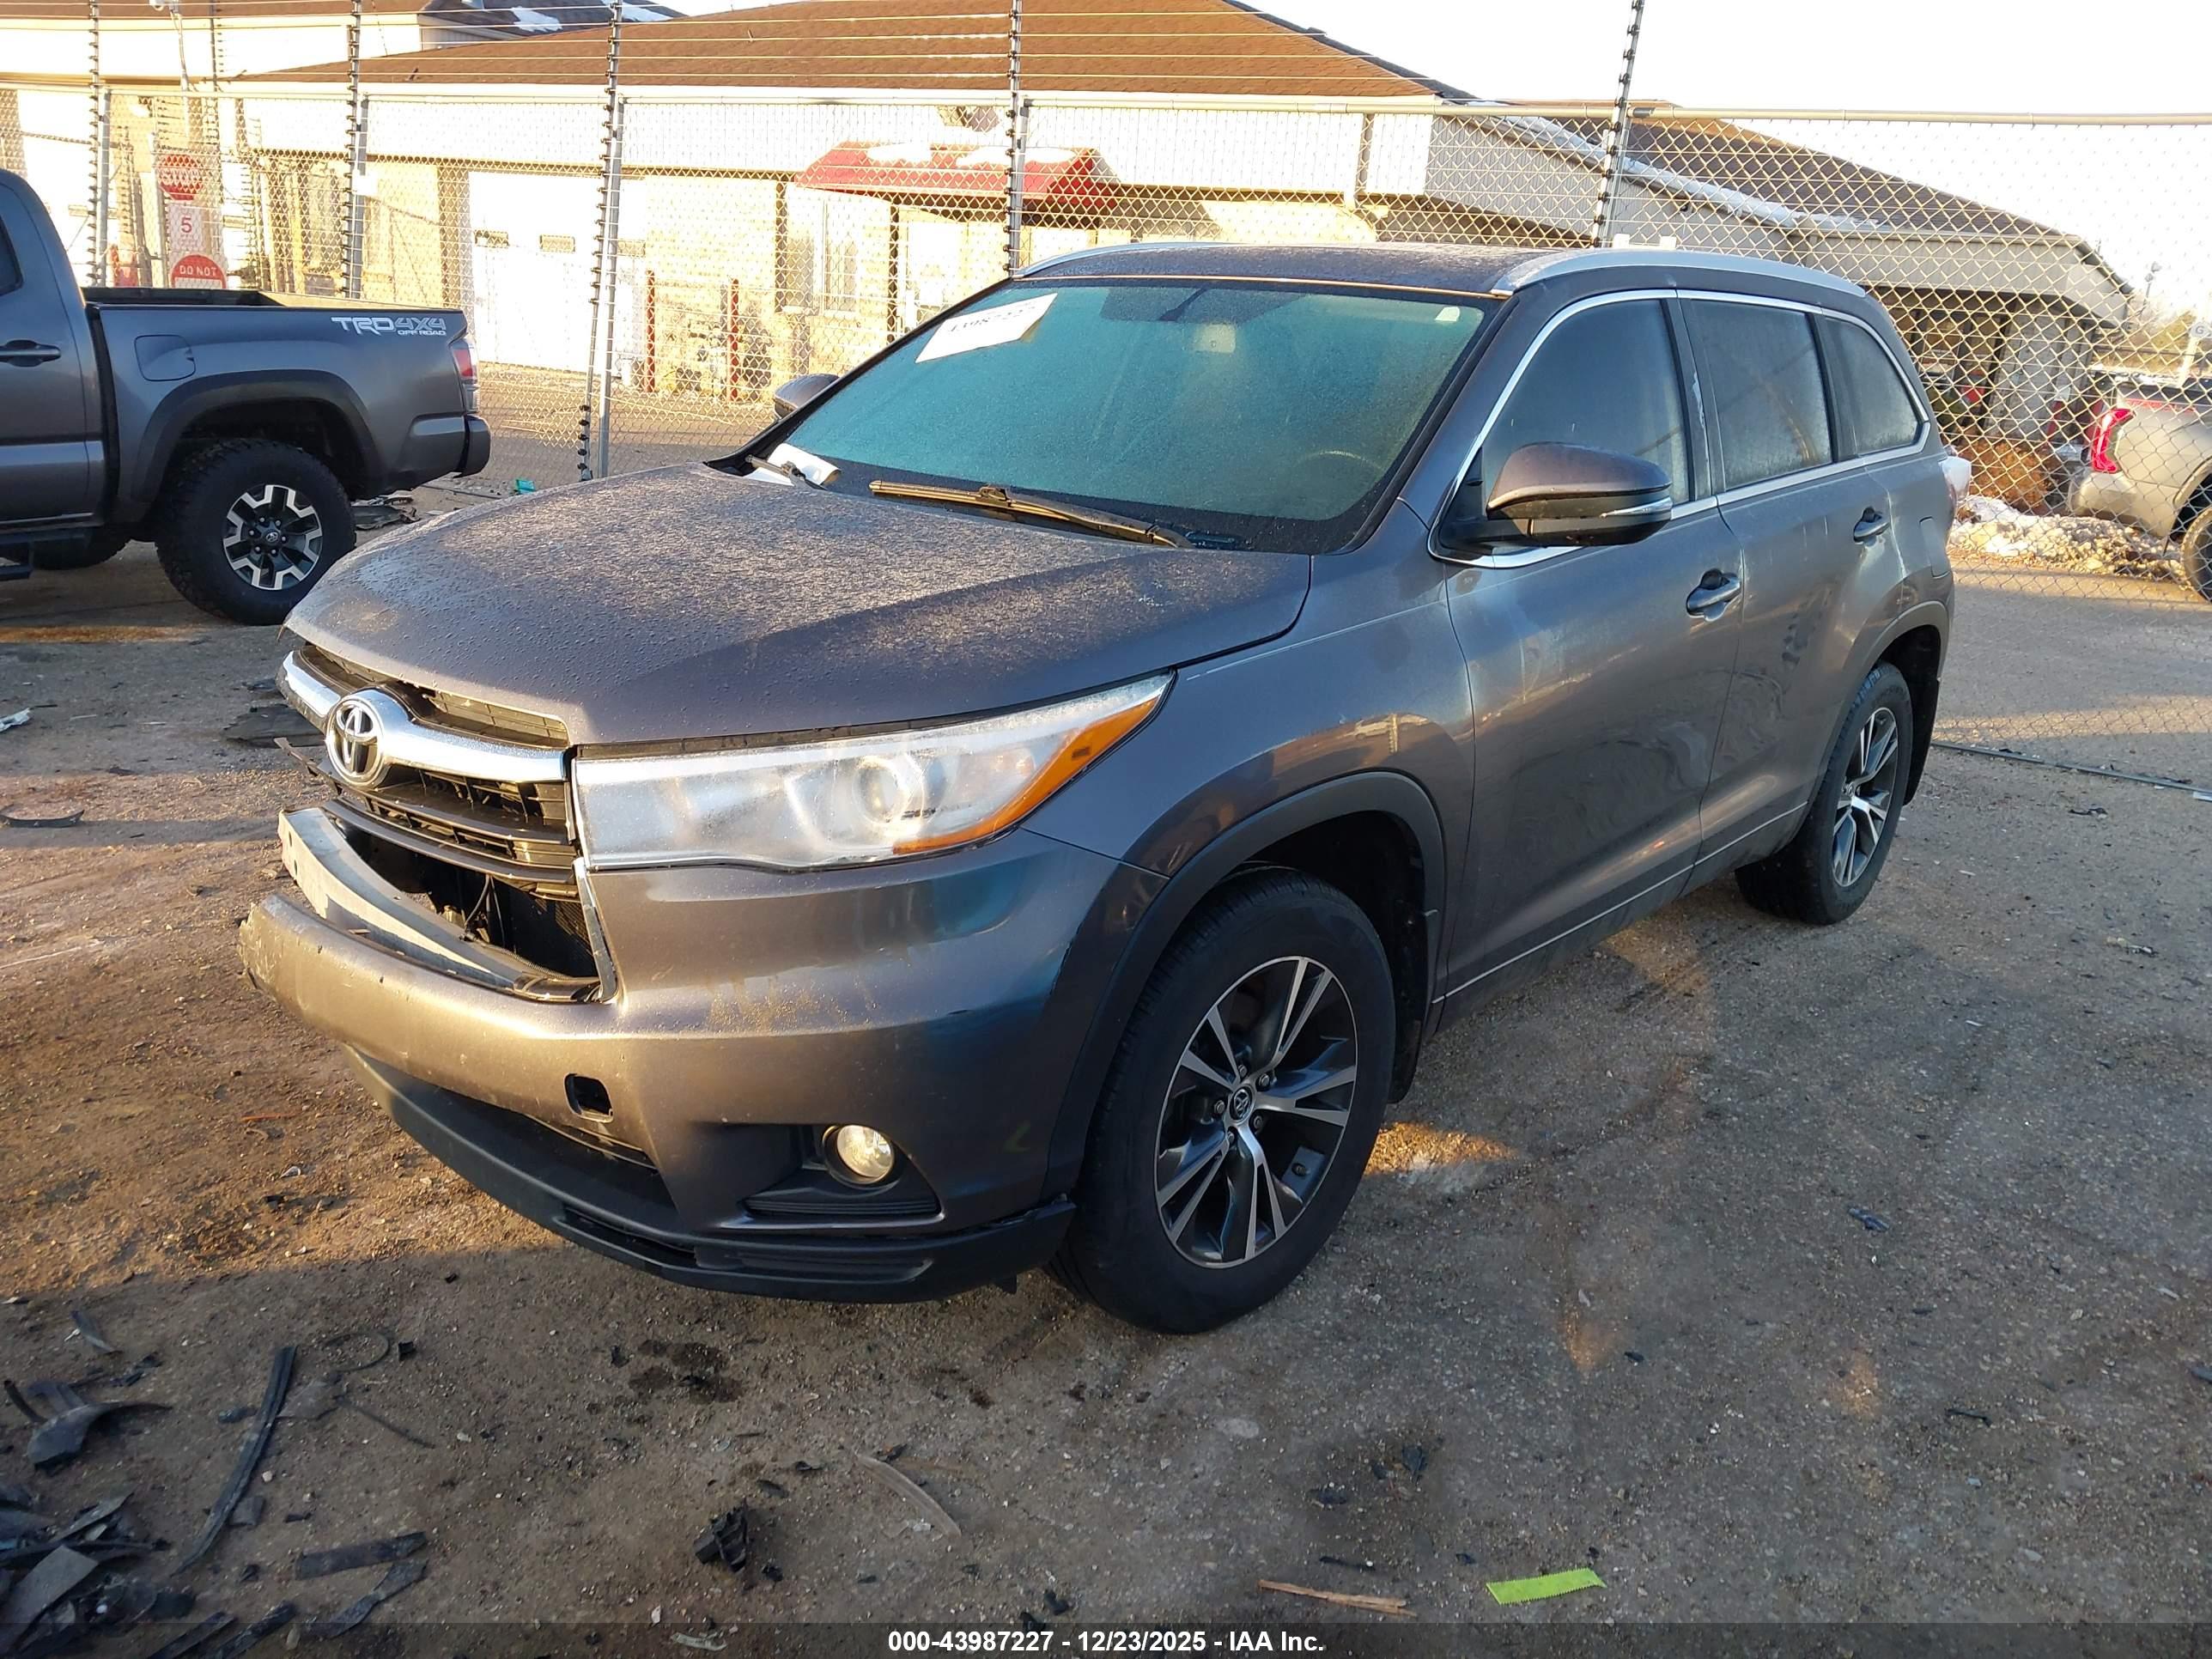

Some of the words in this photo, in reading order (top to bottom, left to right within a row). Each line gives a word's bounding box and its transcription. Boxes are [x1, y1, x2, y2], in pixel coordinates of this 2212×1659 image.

[181, 216, 192, 234] 5
[179, 264, 193, 275] DO
[197, 265, 216, 276] NOT
